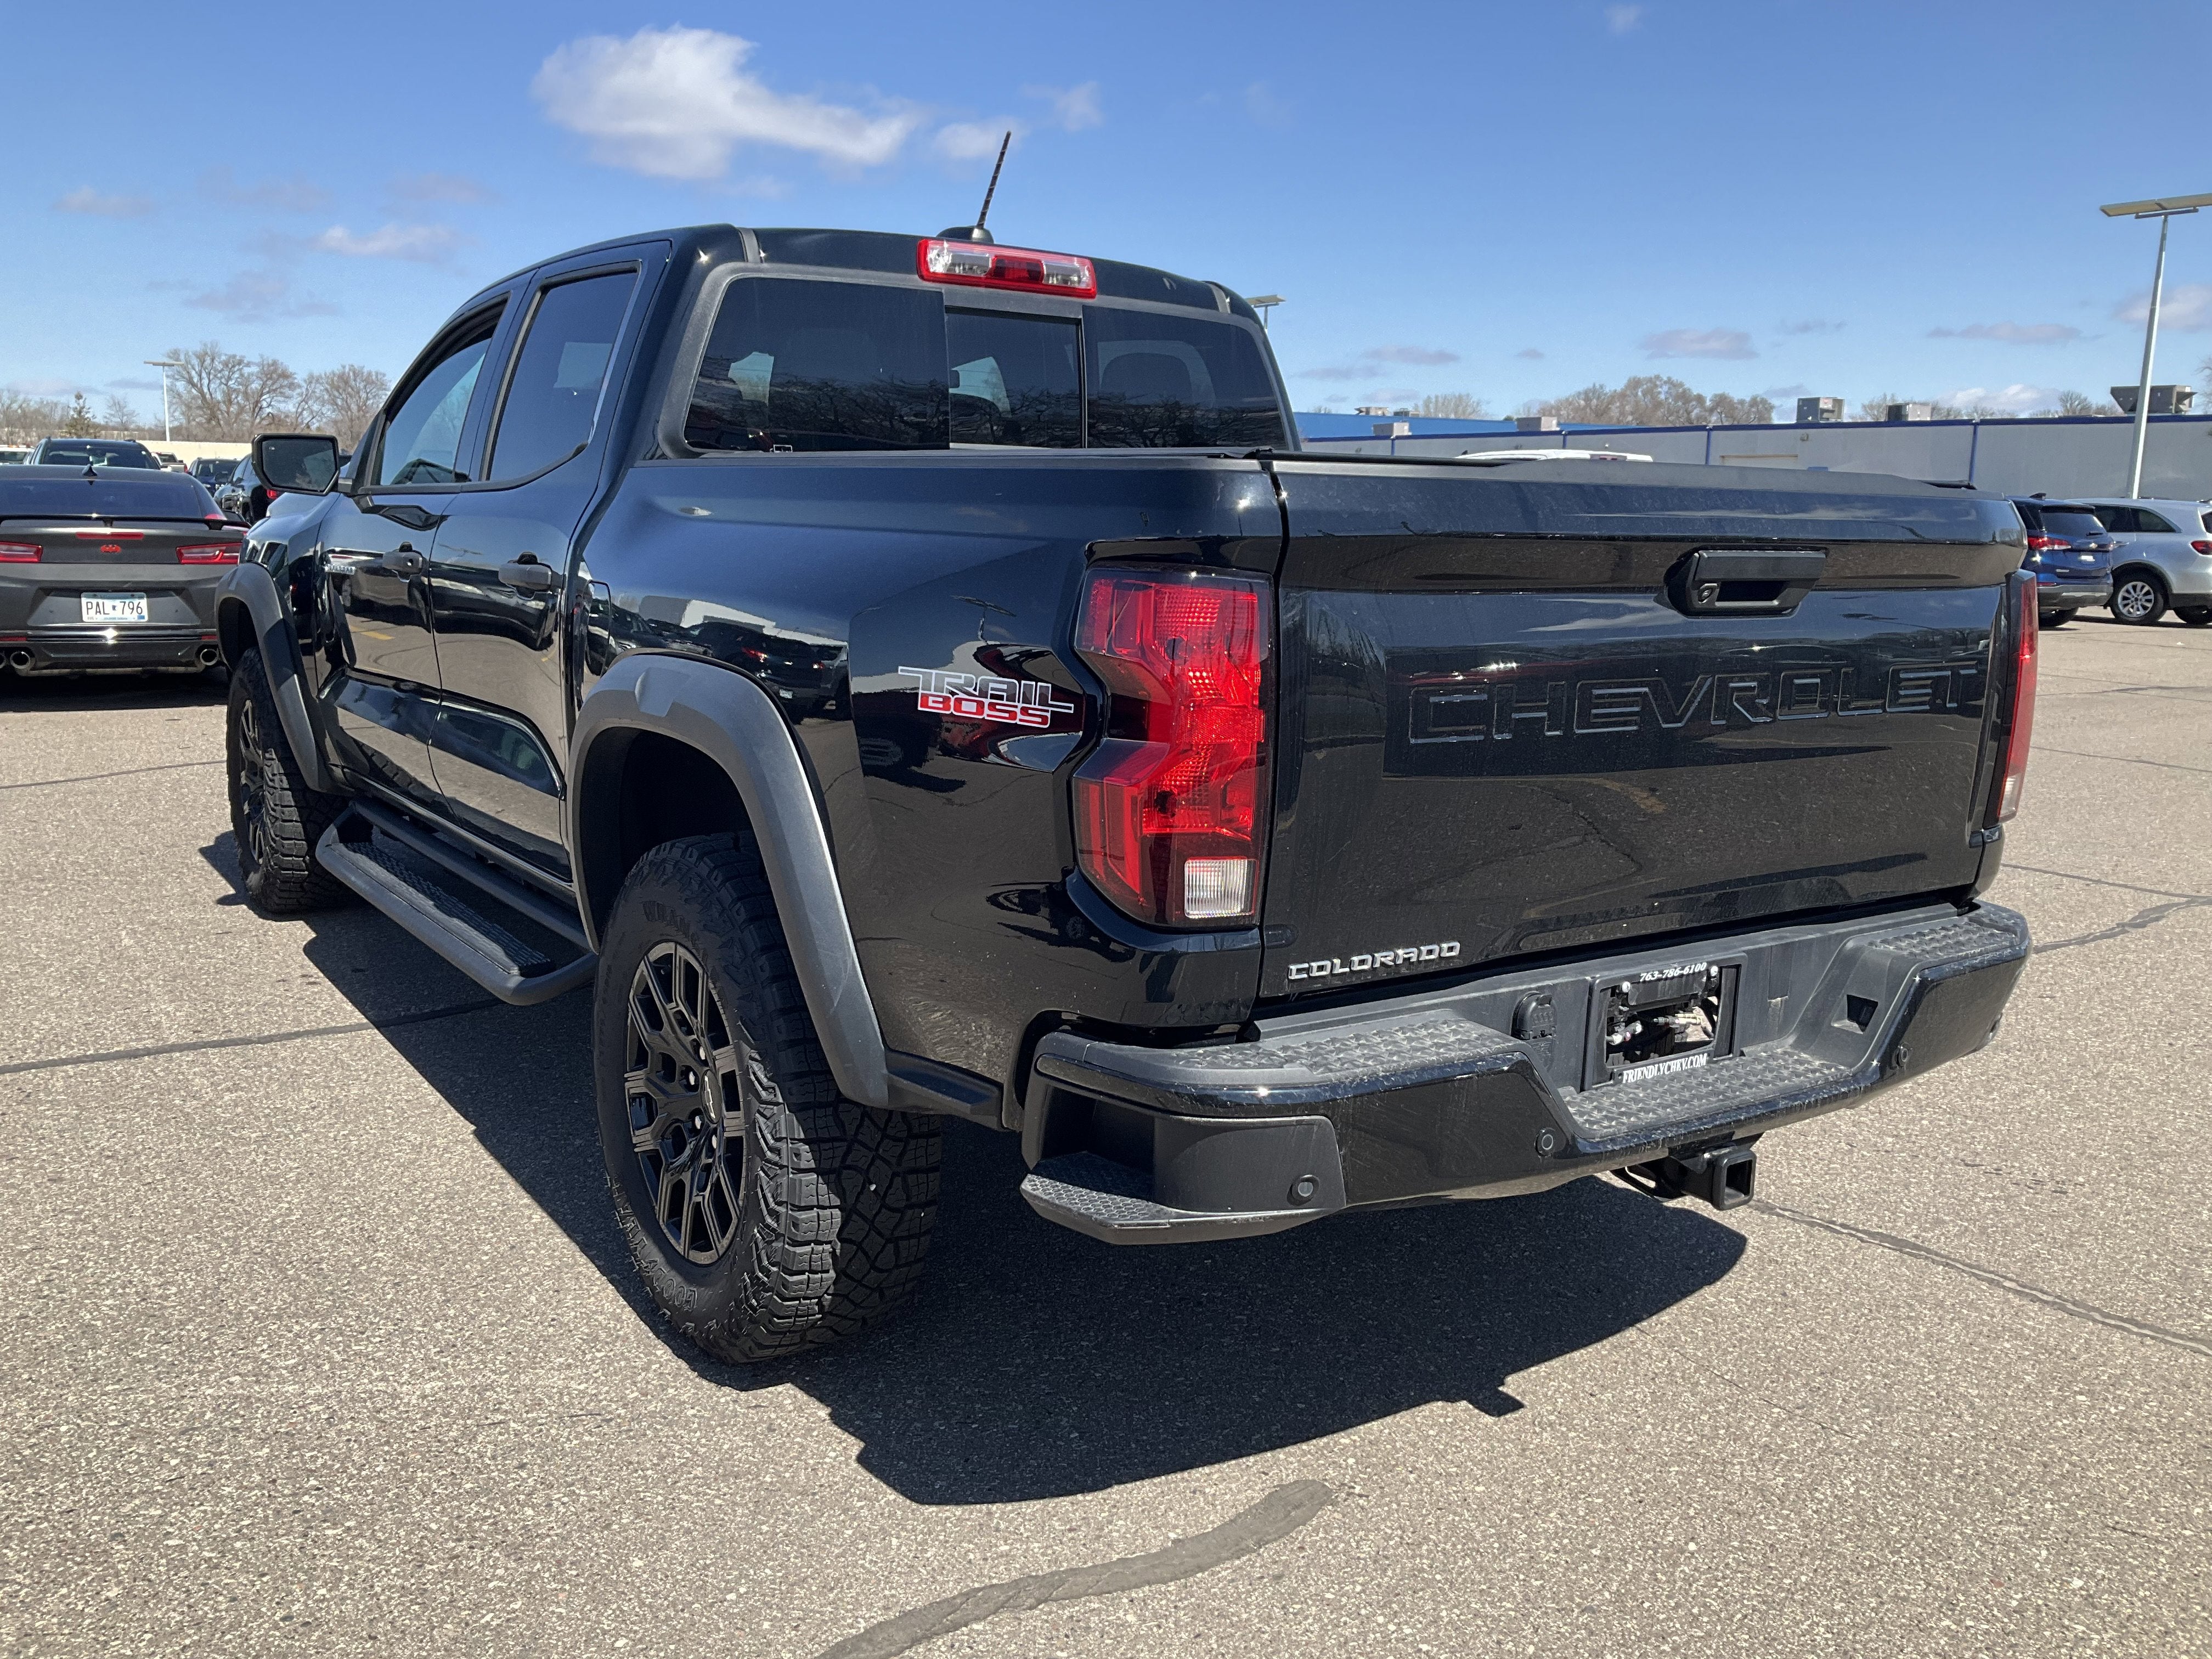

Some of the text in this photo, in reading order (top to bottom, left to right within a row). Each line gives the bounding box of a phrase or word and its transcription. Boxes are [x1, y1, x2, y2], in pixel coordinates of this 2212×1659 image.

[86, 601, 143, 615] PAL 796
[898, 666, 1074, 713] TRAIL
[1409, 661, 1978, 744] CHEVROLET
[918, 692, 1051, 728] BOSS
[1288, 940, 1461, 980] COLORADO
[1639, 962, 1707, 982] 763-786-6100
[1622, 1053, 1708, 1084] FRIENDLYCHEV.COM
